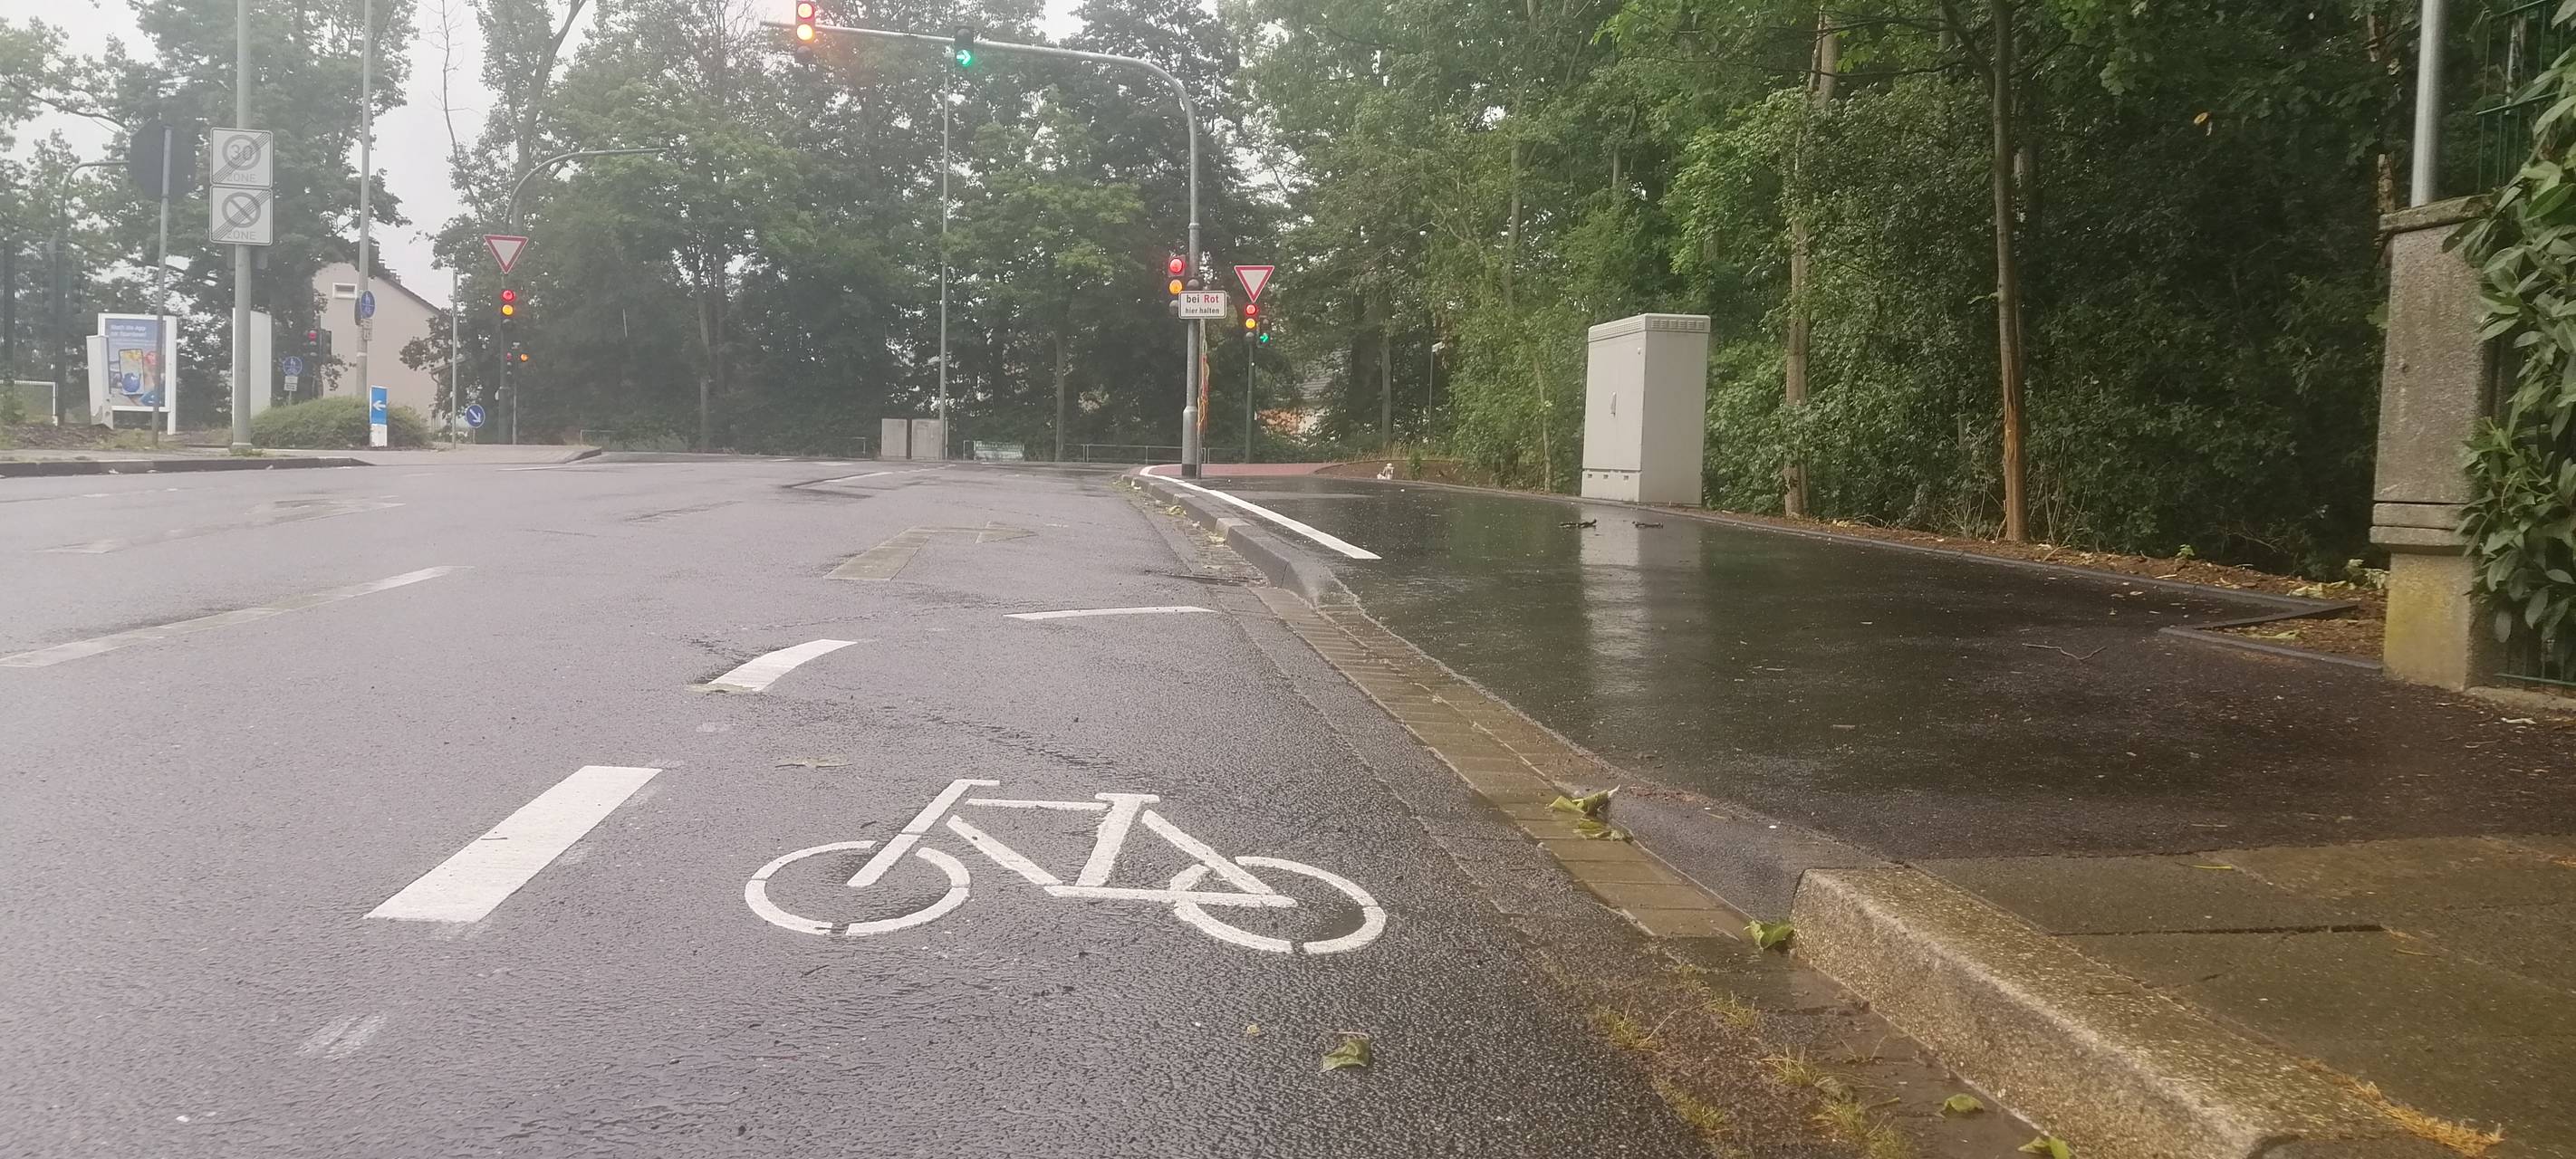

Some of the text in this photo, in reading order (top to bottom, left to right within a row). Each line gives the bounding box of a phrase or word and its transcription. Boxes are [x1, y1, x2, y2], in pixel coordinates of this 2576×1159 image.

[231, 144, 253, 161] 30
[226, 173, 257, 183] ZONE
[226, 230, 257, 240] ZONE
[1187, 294, 1219, 303] bei Rot
